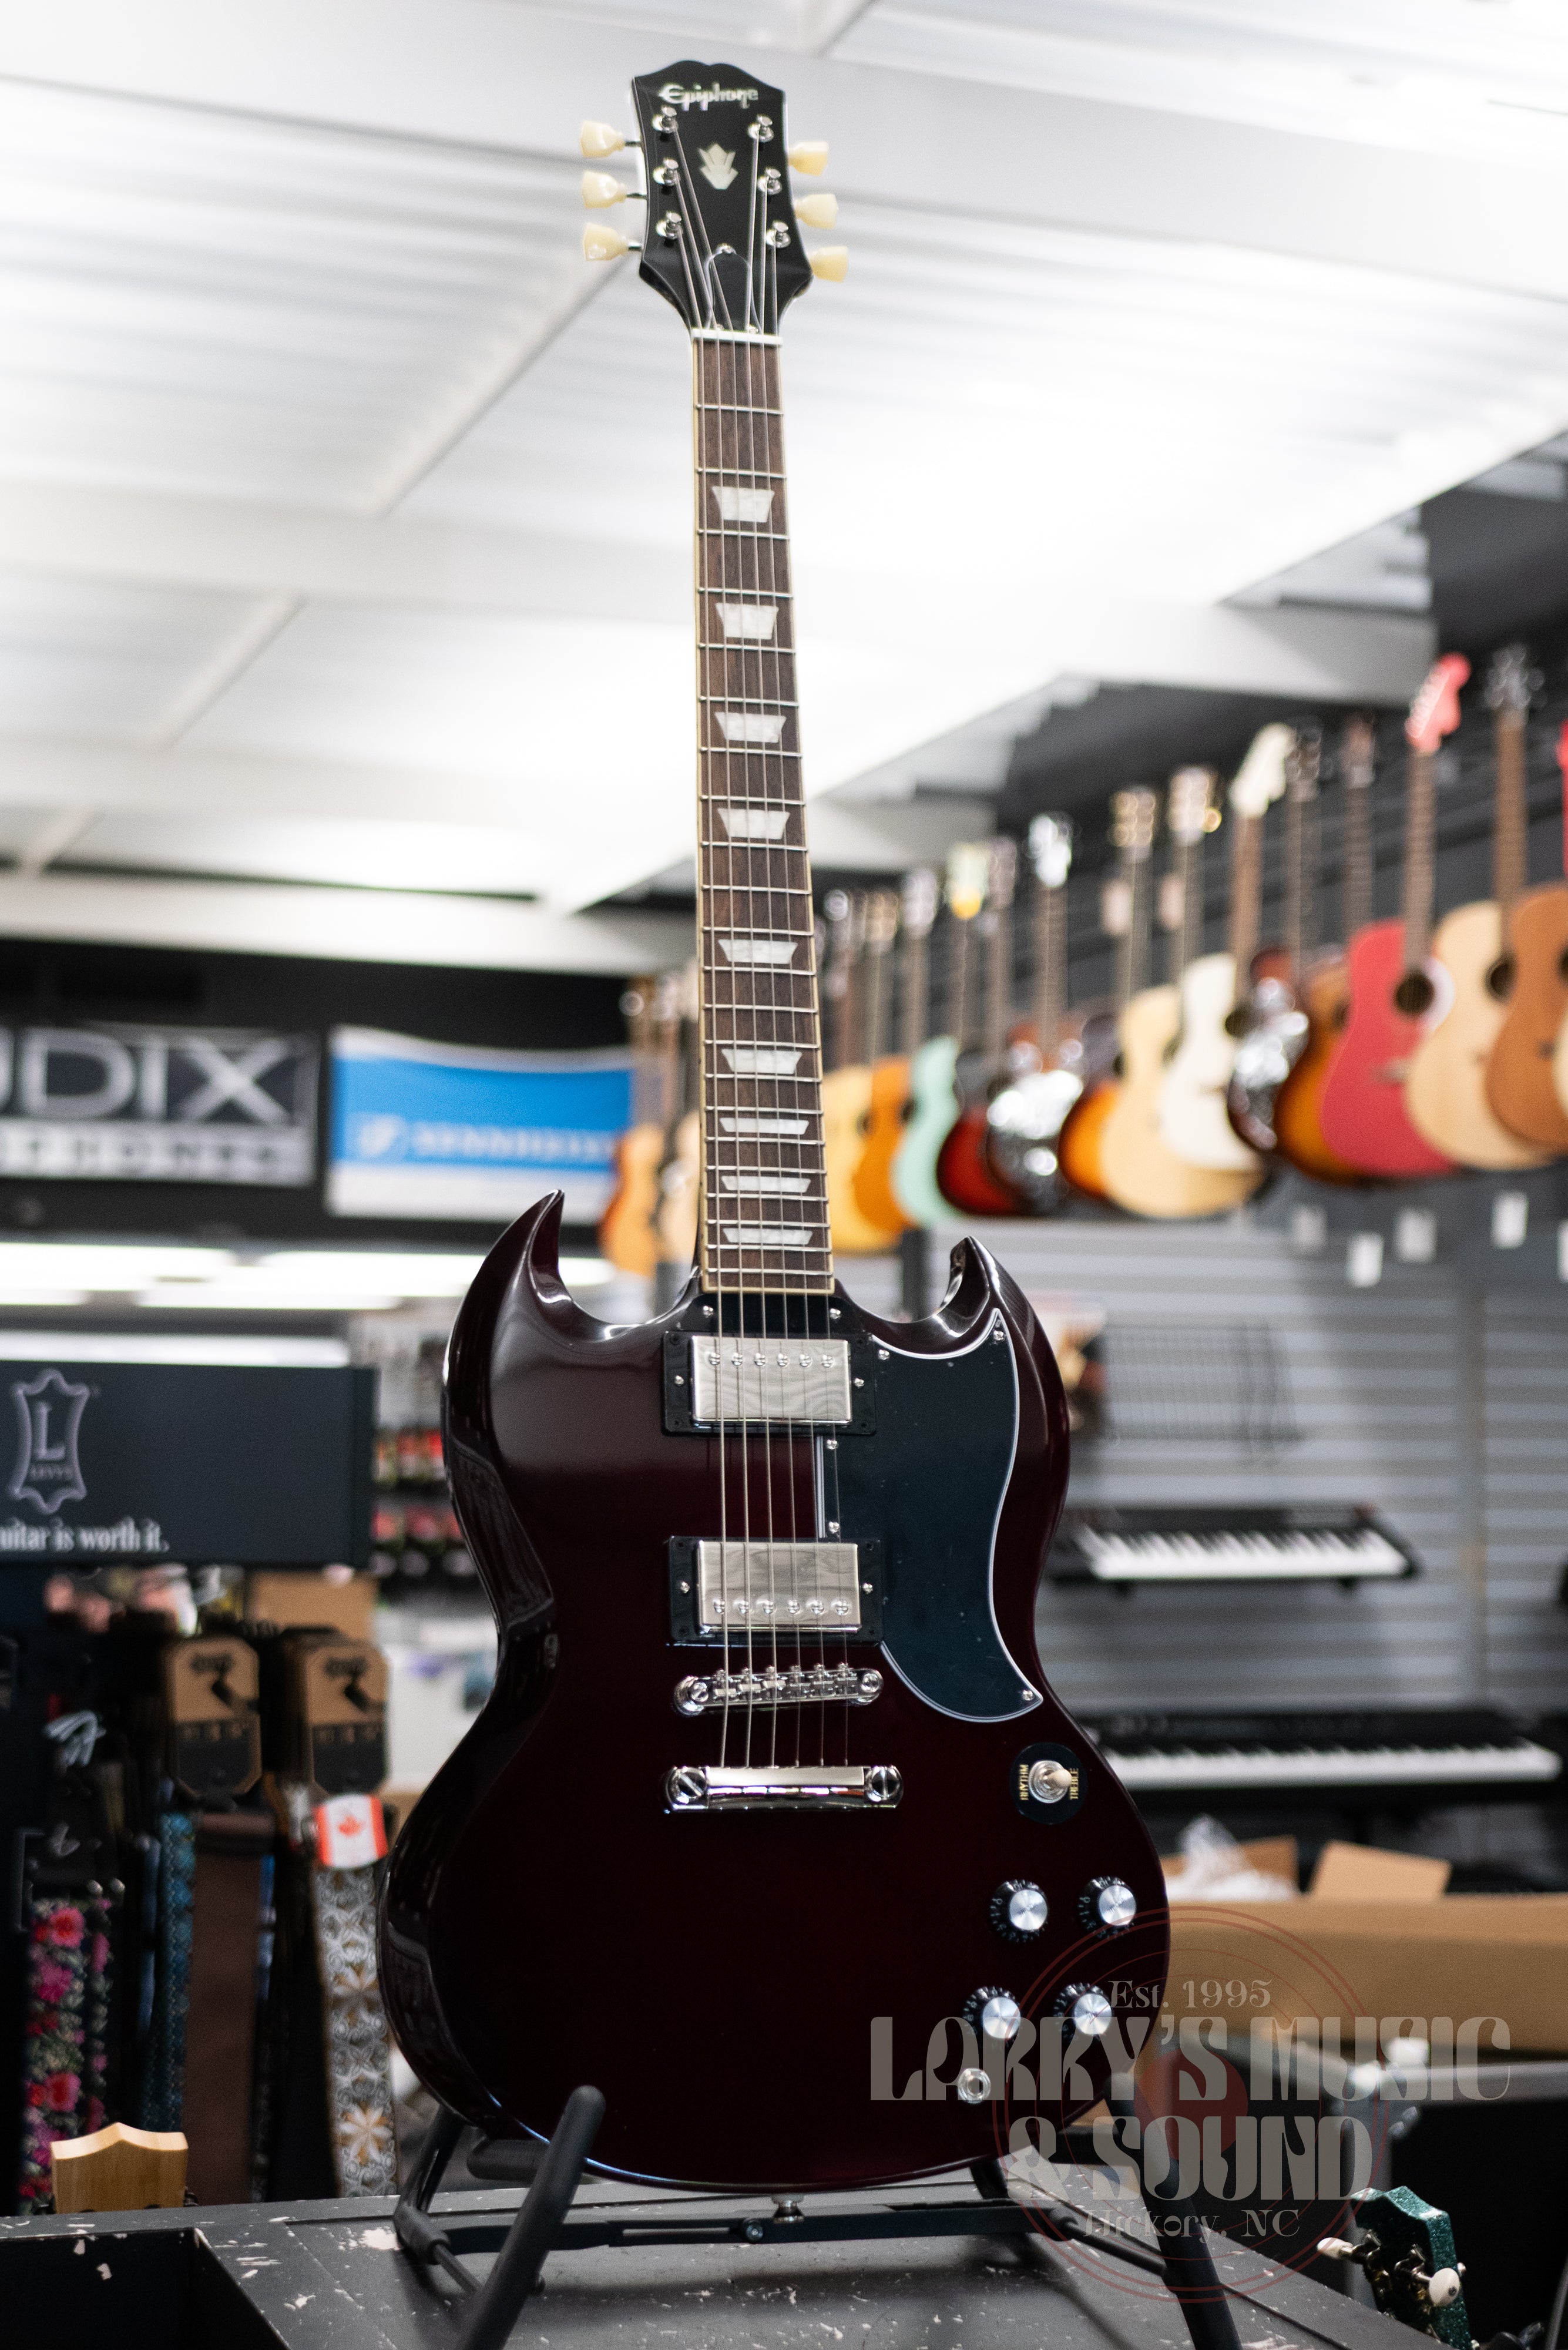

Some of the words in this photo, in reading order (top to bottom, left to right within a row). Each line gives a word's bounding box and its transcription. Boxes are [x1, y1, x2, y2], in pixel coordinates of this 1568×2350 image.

[658, 81, 758, 112] Epiphone
[0, 1029, 293, 1122] DIX
[51, 1517, 75, 1552] is
[76, 1516, 141, 1552] worth
[142, 1517, 170, 1553] it.
[1019, 1764, 1029, 1801] RHYTHM
[1069, 1768, 1079, 1800] TREBLE
